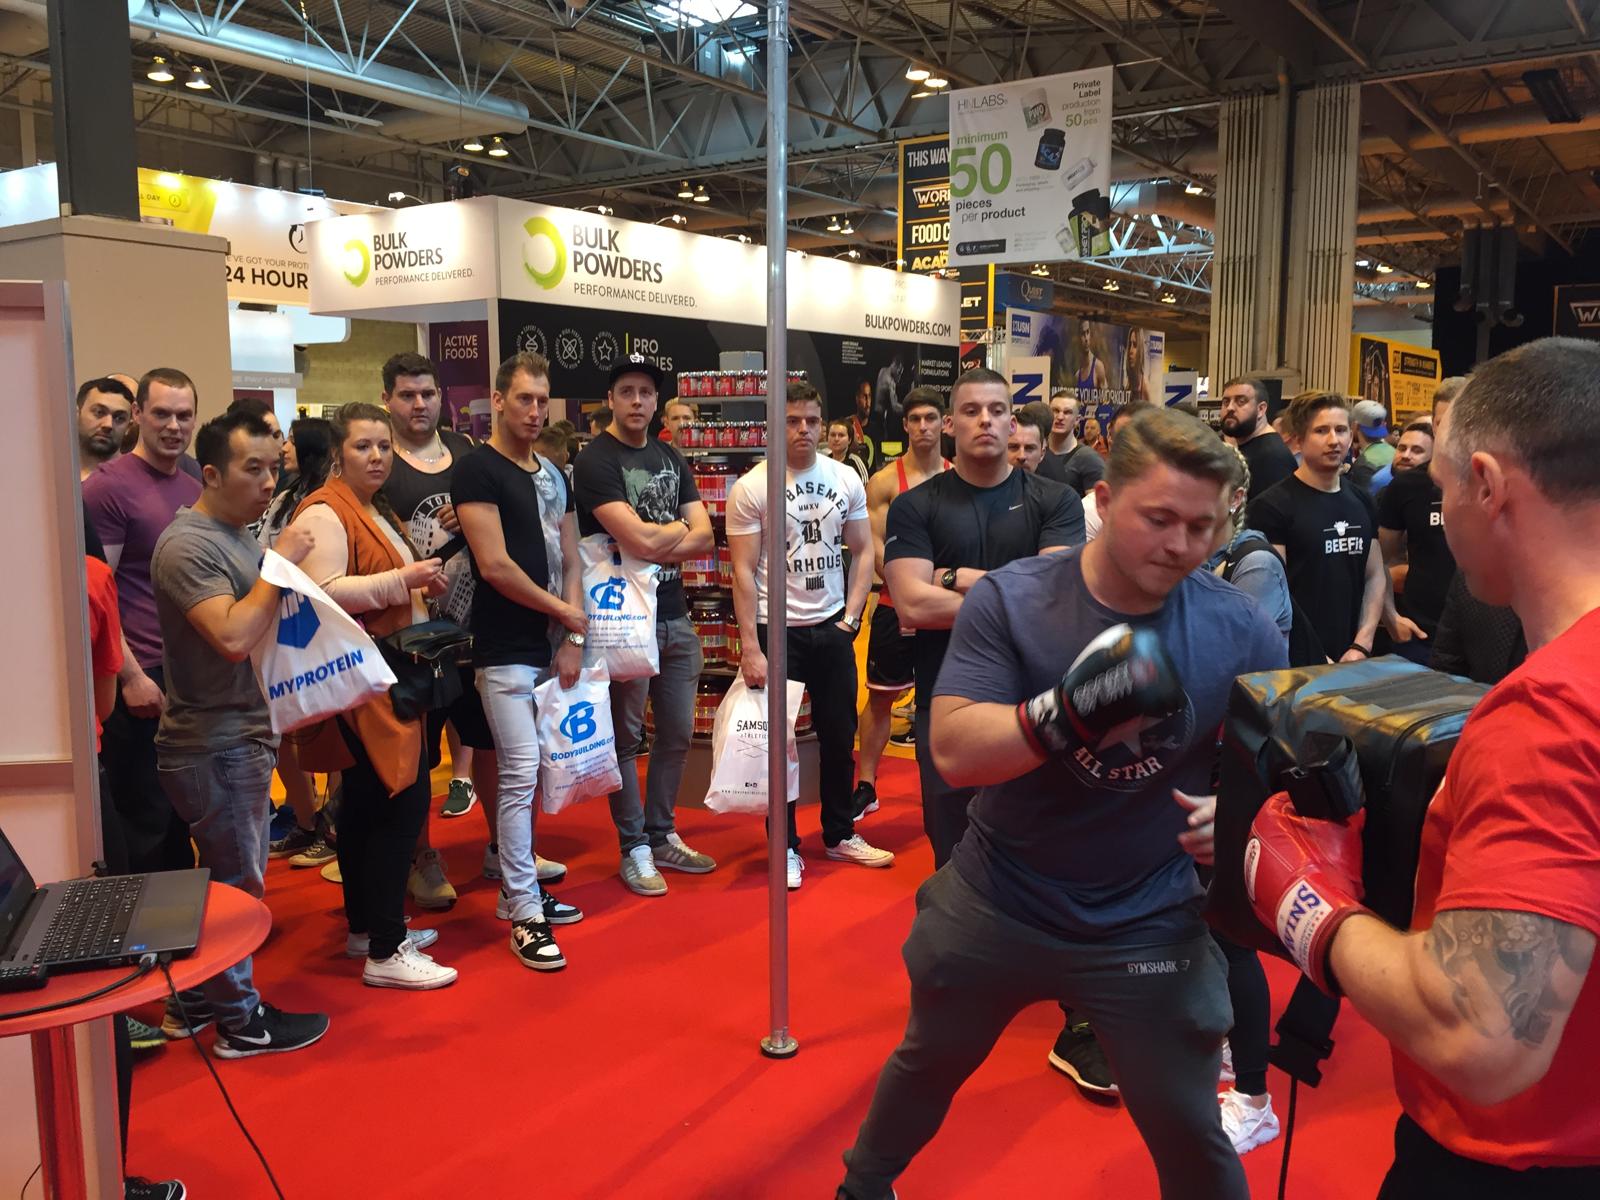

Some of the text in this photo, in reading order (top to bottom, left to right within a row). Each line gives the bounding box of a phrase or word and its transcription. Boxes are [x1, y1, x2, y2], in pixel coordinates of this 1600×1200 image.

[1078, 88, 1101, 98] Label
[1065, 113, 1082, 127] 50
[956, 130, 1008, 145] minimum
[907, 150, 929, 168] THIS
[950, 143, 1012, 198] 50
[955, 198, 992, 212] pieces
[961, 206, 1026, 224] per product
[373, 232, 408, 251] BULK
[573, 224, 620, 253] BULK
[911, 223, 942, 244] FOOD
[245, 257, 263, 265] GOT
[264, 258, 286, 267] YOUR
[374, 247, 443, 270] POWDERS
[573, 250, 663, 284] POWDERS
[251, 268, 309, 290] HOUR
[375, 272, 430, 286] PERFORMANCE
[574, 282, 698, 308] PERFORMANCE DELIVERED.
[865, 313, 951, 337] BULKPOWDERS.COM
[445, 334, 478, 347] ACTIVE
[633, 337, 659, 354] PRO
[445, 347, 479, 360] FOODS
[786, 481, 849, 522] BASEMEN
[798, 503, 819, 512] MMXV
[269, 650, 364, 700] MYPROTEIN
[736, 720, 768, 732] SAMSO
[1108, 756, 1163, 780] STAR
[1127, 960, 1178, 974] GYMSHARK
